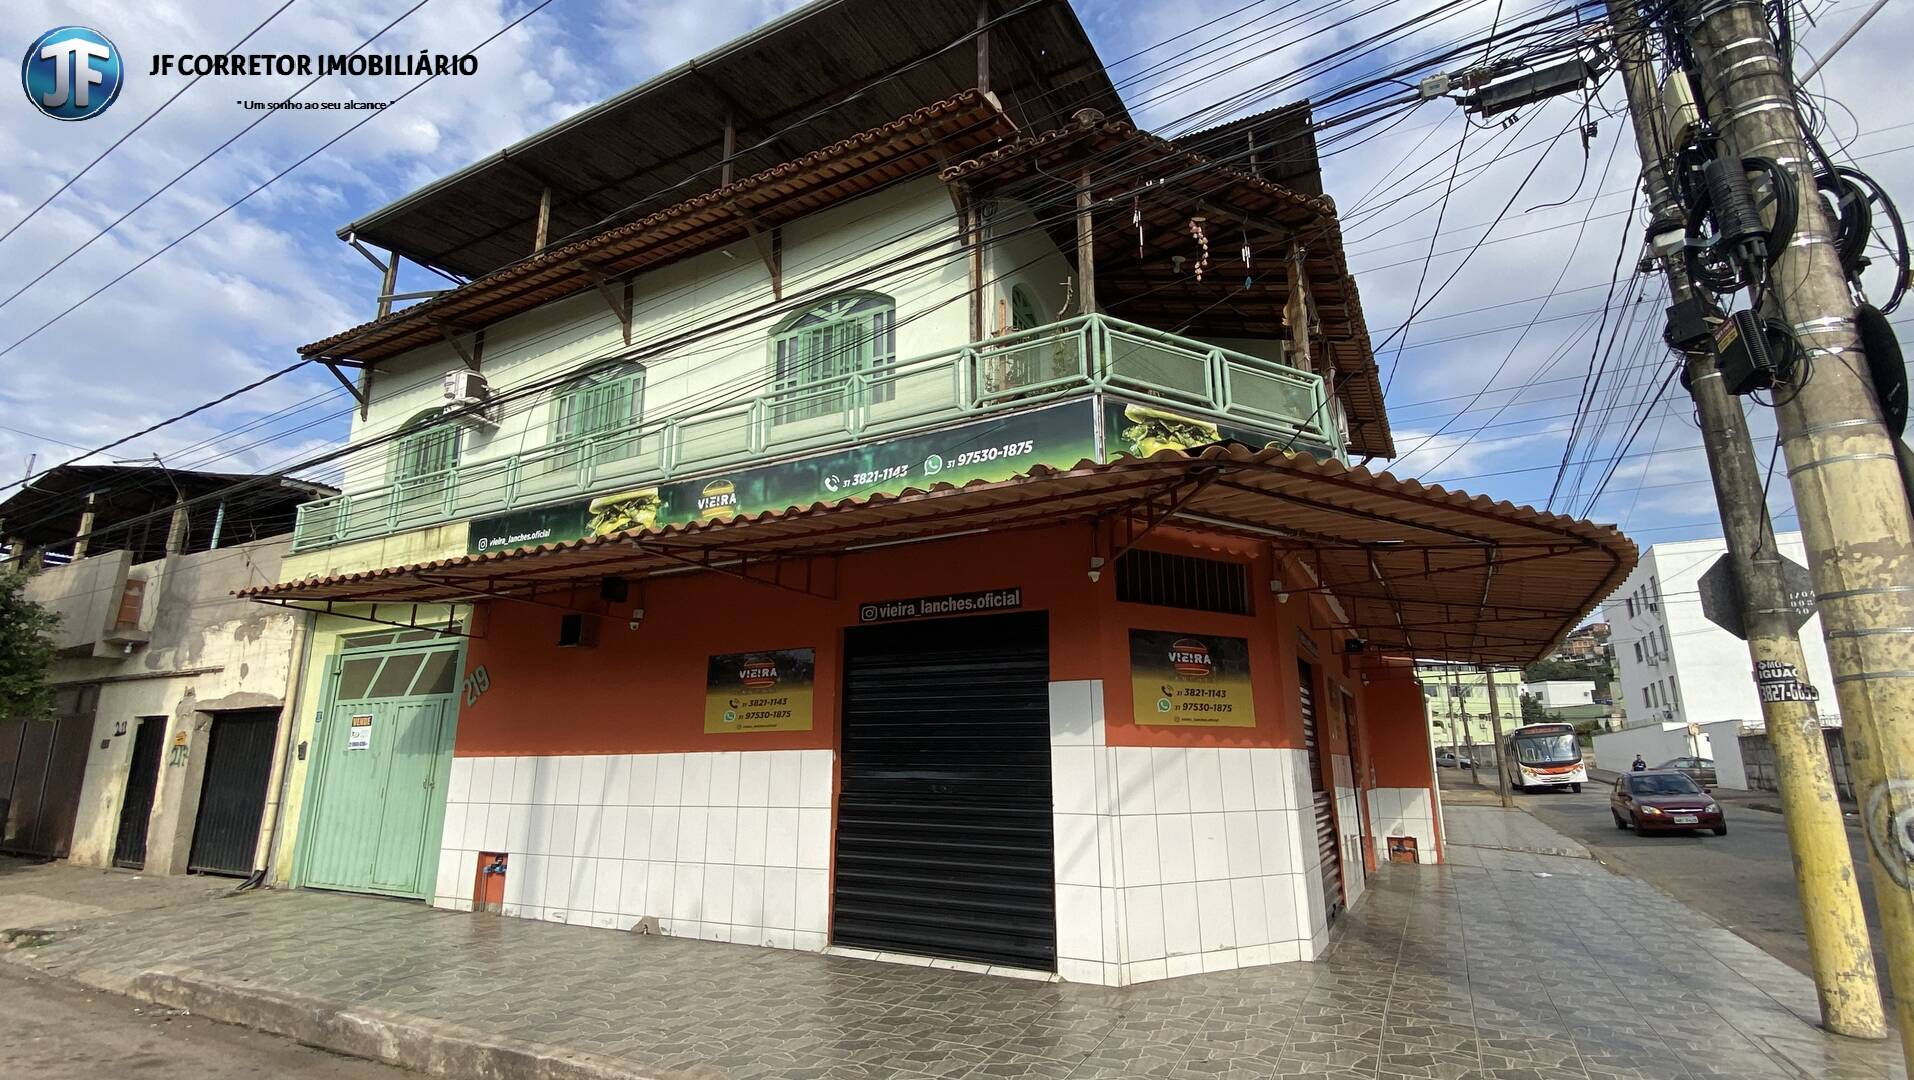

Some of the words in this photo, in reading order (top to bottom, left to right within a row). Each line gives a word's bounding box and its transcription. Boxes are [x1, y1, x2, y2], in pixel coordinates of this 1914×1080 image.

[957, 440, 1034, 467] 97530-1875
[852, 465, 909, 486] 3821-1143
[698, 493, 737, 511] VIEIRA
[879, 590, 1020, 619] vieira_lanches.oficial
[1168, 652, 1212, 665] VIEIRA
[739, 668, 778, 679] VIEIRA
[463, 664, 490, 707] 219
[1184, 688, 1227, 698] 3821-1143
[748, 698, 788, 707] 3821-1143
[1182, 703, 1233, 712] 97530-1875
[745, 710, 791, 720] 97530-1875
